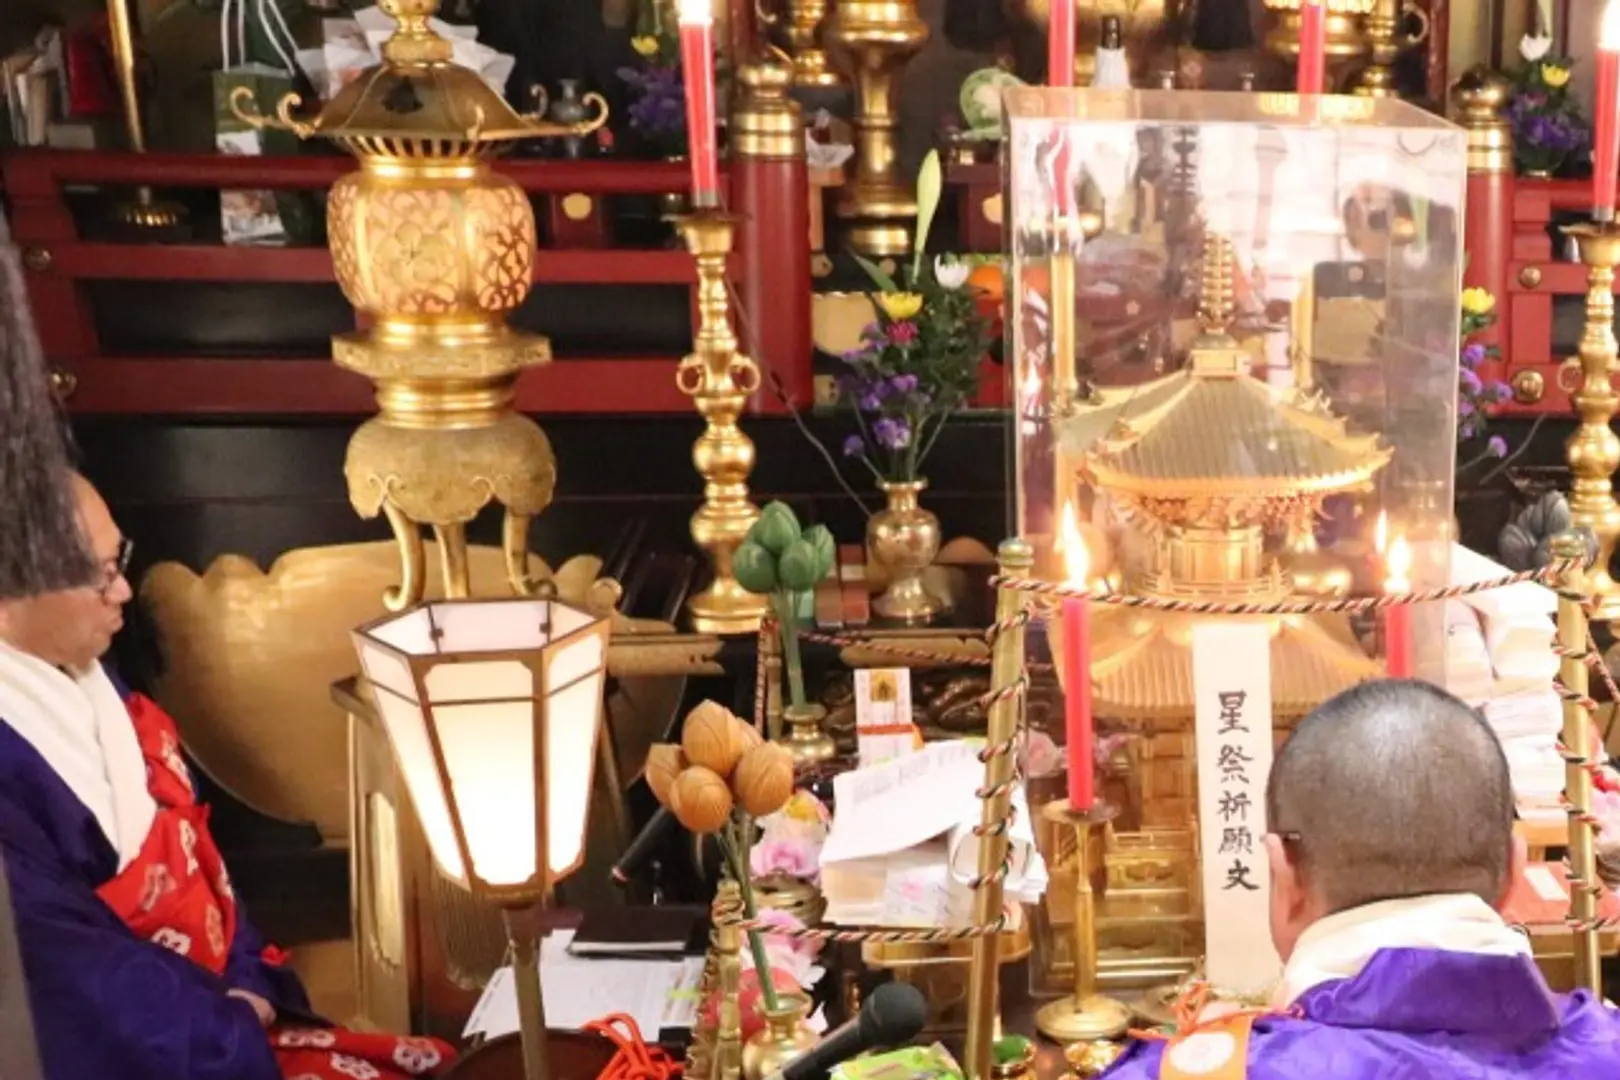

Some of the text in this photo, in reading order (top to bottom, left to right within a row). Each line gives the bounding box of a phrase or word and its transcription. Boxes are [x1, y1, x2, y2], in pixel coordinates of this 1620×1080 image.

[1217, 690, 1260, 890] 星祭祈願文
